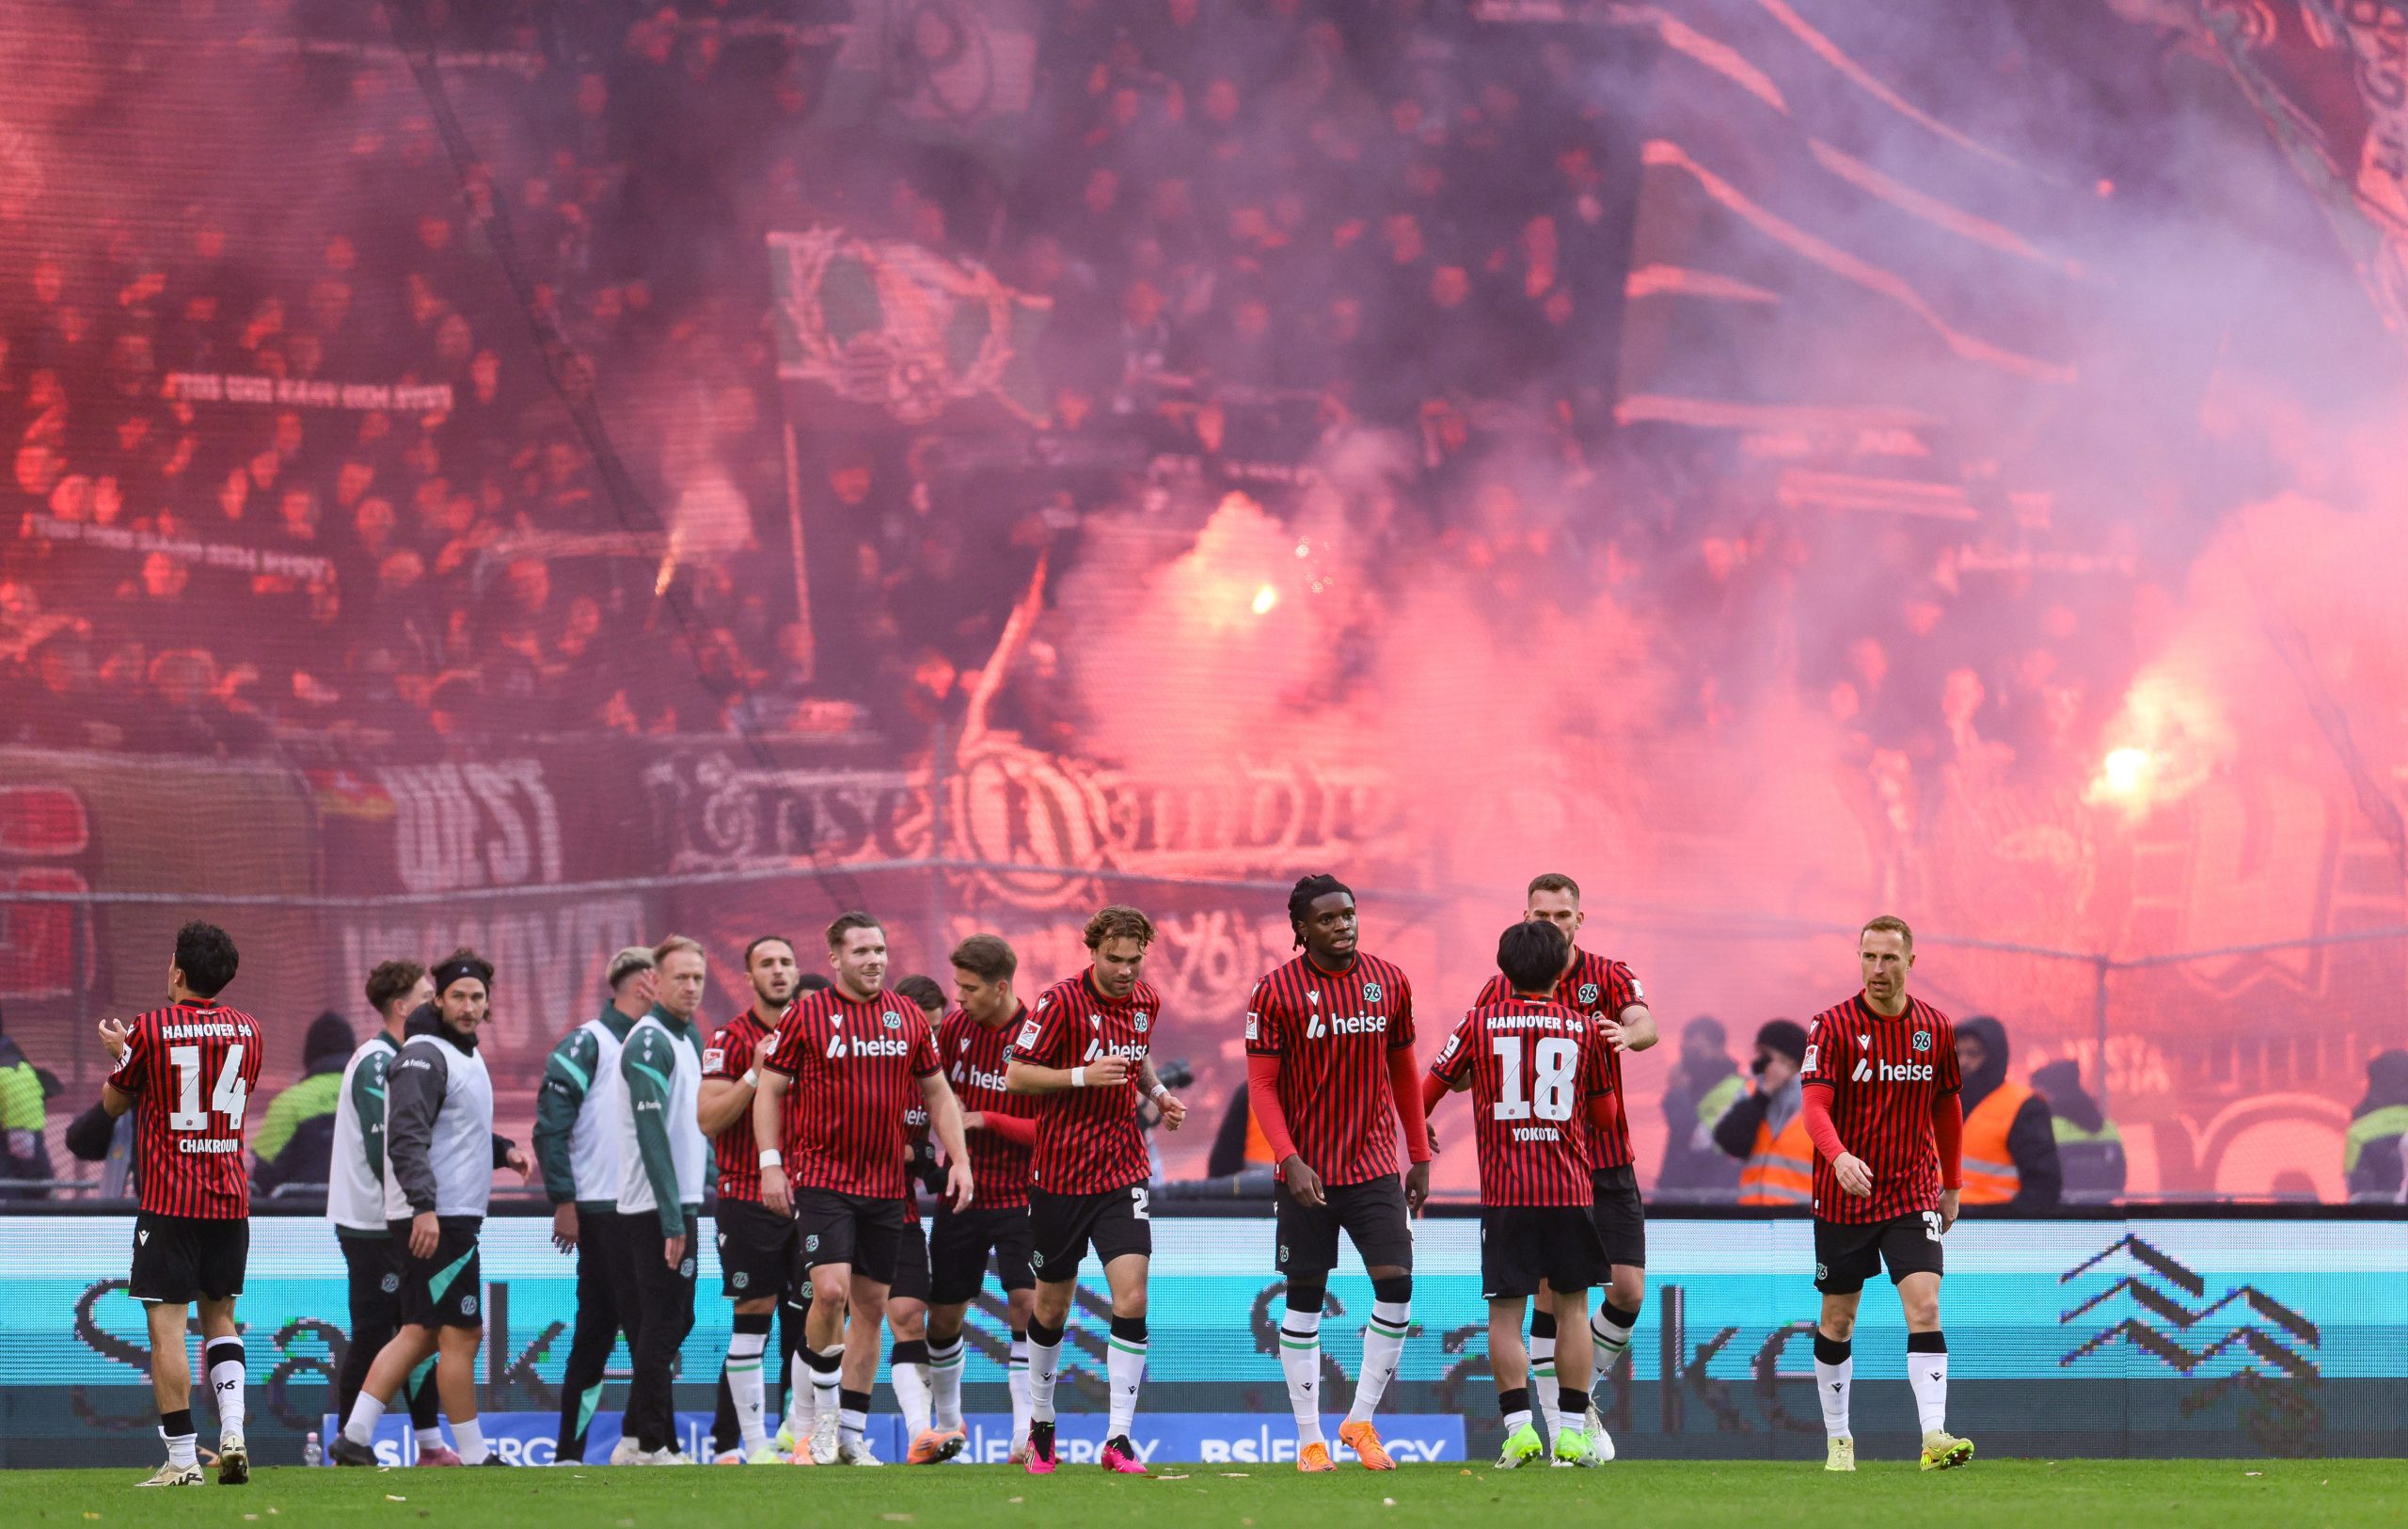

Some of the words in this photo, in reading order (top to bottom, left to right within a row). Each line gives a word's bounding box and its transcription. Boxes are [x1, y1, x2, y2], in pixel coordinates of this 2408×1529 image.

[1364, 984, 1381, 999] 96
[1579, 985, 1598, 1001] 96
[883, 1011, 901, 1027] 96
[1134, 1015, 1148, 1030] 96
[1332, 1011, 1386, 1035] heise
[1486, 1016, 1561, 1030] HANNOVER
[1565, 1019, 1584, 1033] 96
[162, 1023, 234, 1039] HANNOVER
[237, 1024, 252, 1037] 96
[852, 1035, 908, 1057] heise
[1913, 1033, 1931, 1049] 96
[970, 1065, 1007, 1091] heis
[1493, 1036, 1579, 1121] 18
[1879, 1059, 1933, 1081] heise
[169, 1043, 246, 1130] 14
[904, 1106, 927, 1125] eis
[1512, 1127, 1560, 1141] YOKOTA
[180, 1139, 238, 1154] CHAKROUN
[1131, 1187, 1149, 1220] 2
[462, 1297, 478, 1314] 96
[215, 1379, 236, 1394] 96
